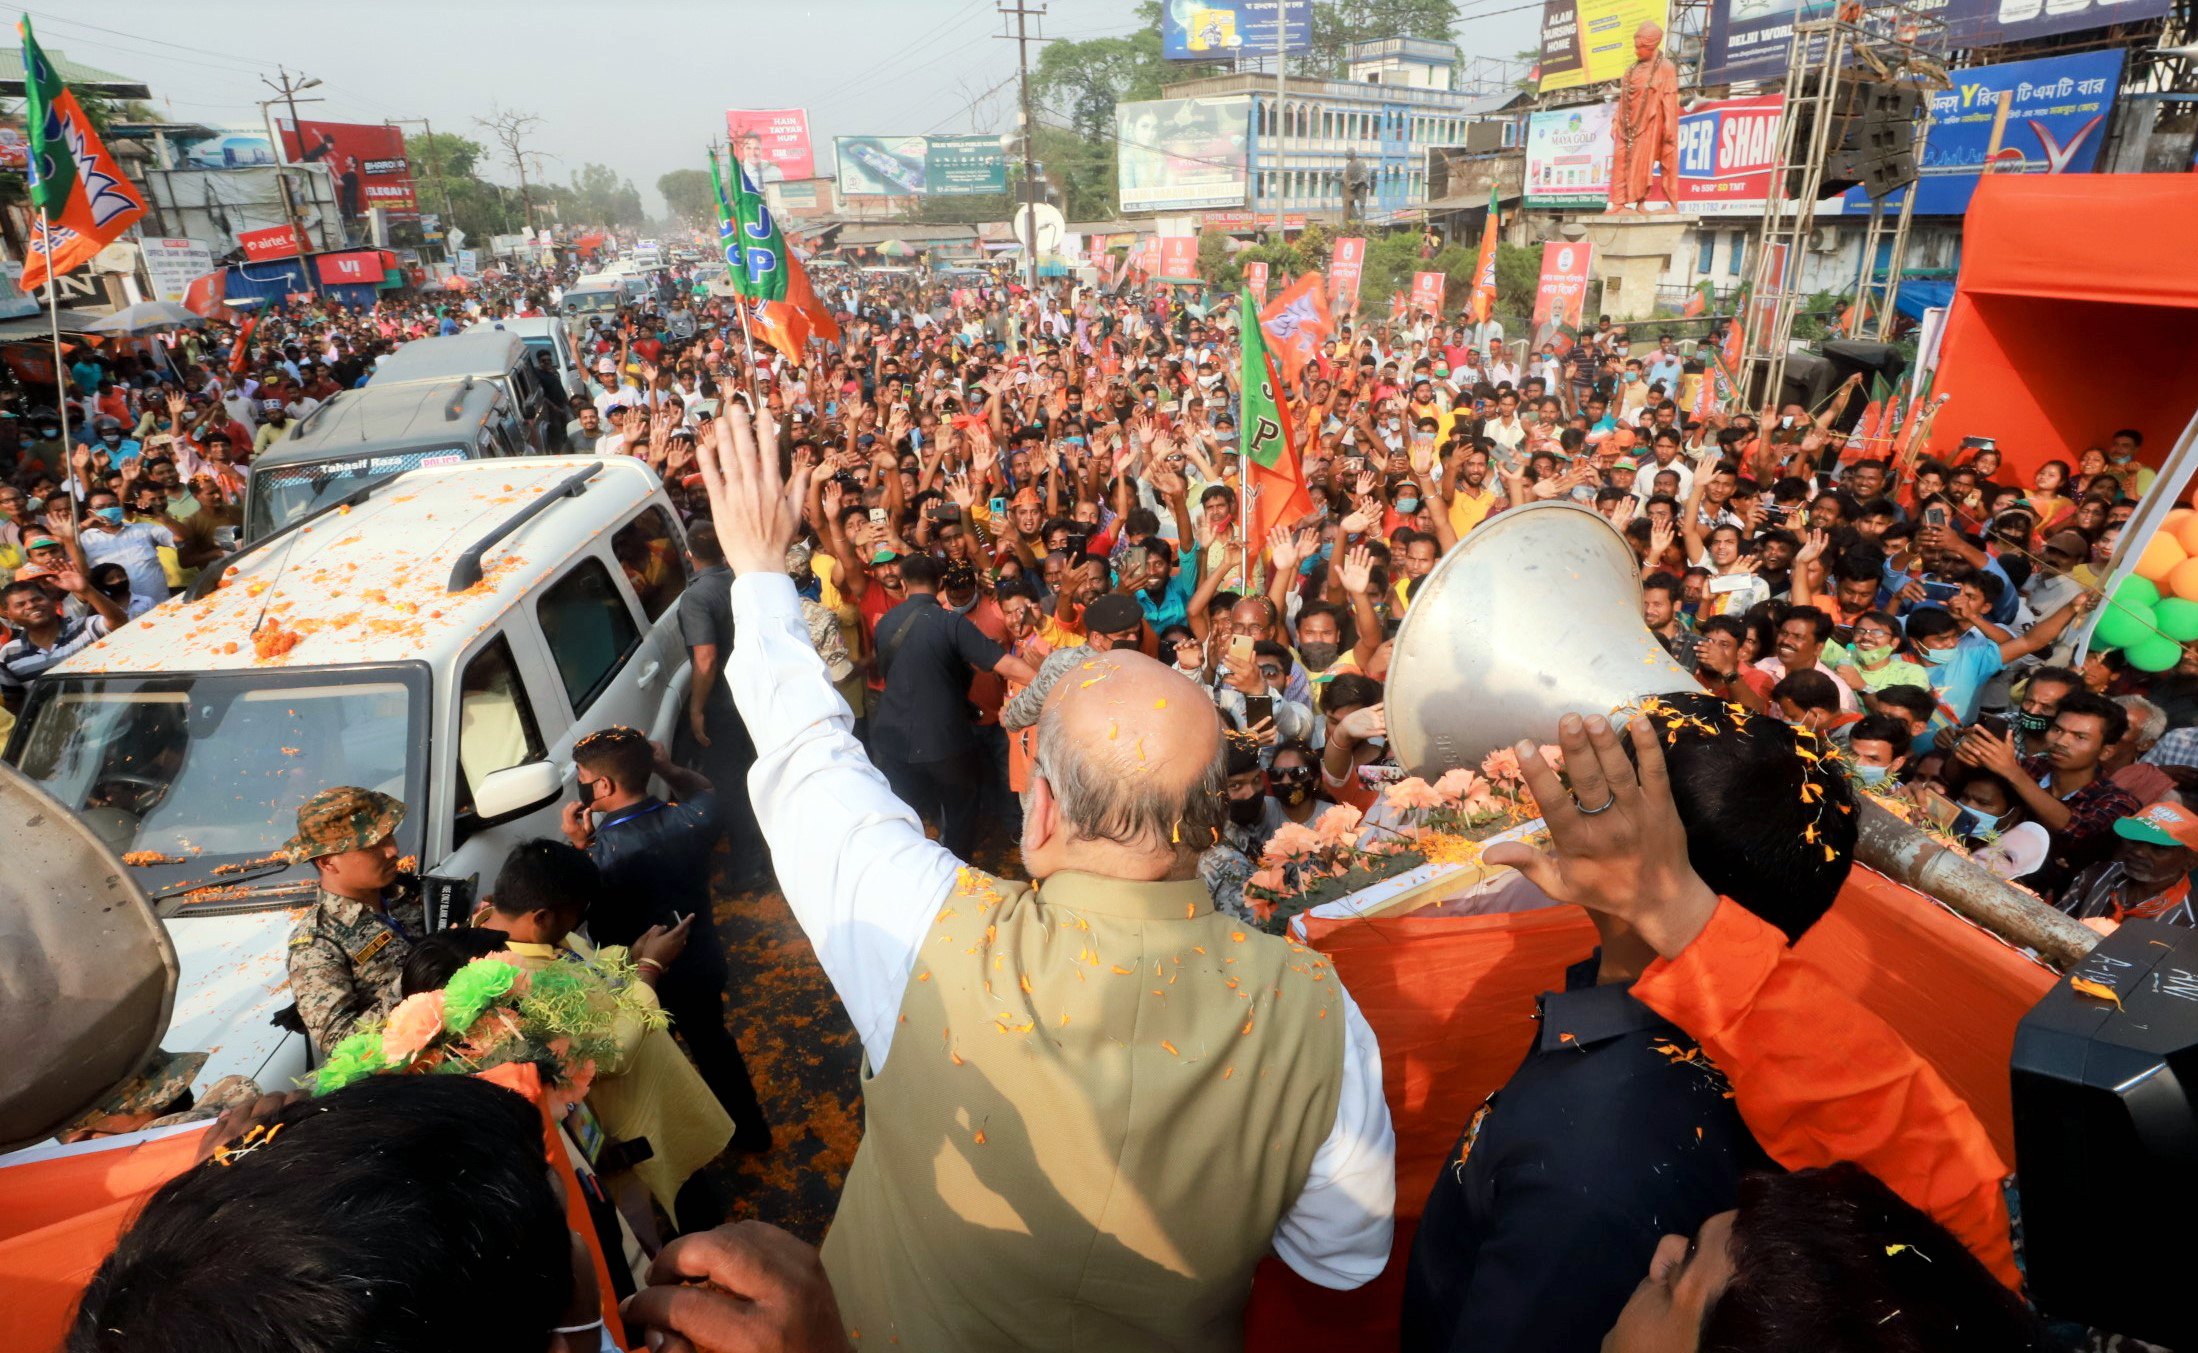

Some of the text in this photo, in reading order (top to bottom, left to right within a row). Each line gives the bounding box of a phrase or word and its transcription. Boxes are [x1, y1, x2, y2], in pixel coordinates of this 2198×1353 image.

[1549, 10, 1574, 26] ALAM
[1543, 23, 1577, 41] NURSING
[1728, 31, 1759, 48] DELHI
[1547, 38, 1571, 53] HOME
[2077, 78, 2107, 96] বার
[769, 126, 803, 134] TAYYAR
[1552, 133, 1597, 145] MAYA GOLD
[1691, 185, 1701, 193] Fe
[1717, 184, 1728, 192] SD
[1729, 182, 1746, 191] TMT
[1205, 213, 1226, 221] HOTEL
[259, 234, 287, 250] airtel
[320, 457, 402, 474] Tahasif Raza
[423, 456, 458, 468] POLICE
[441, 894, 450, 904] ONLY
